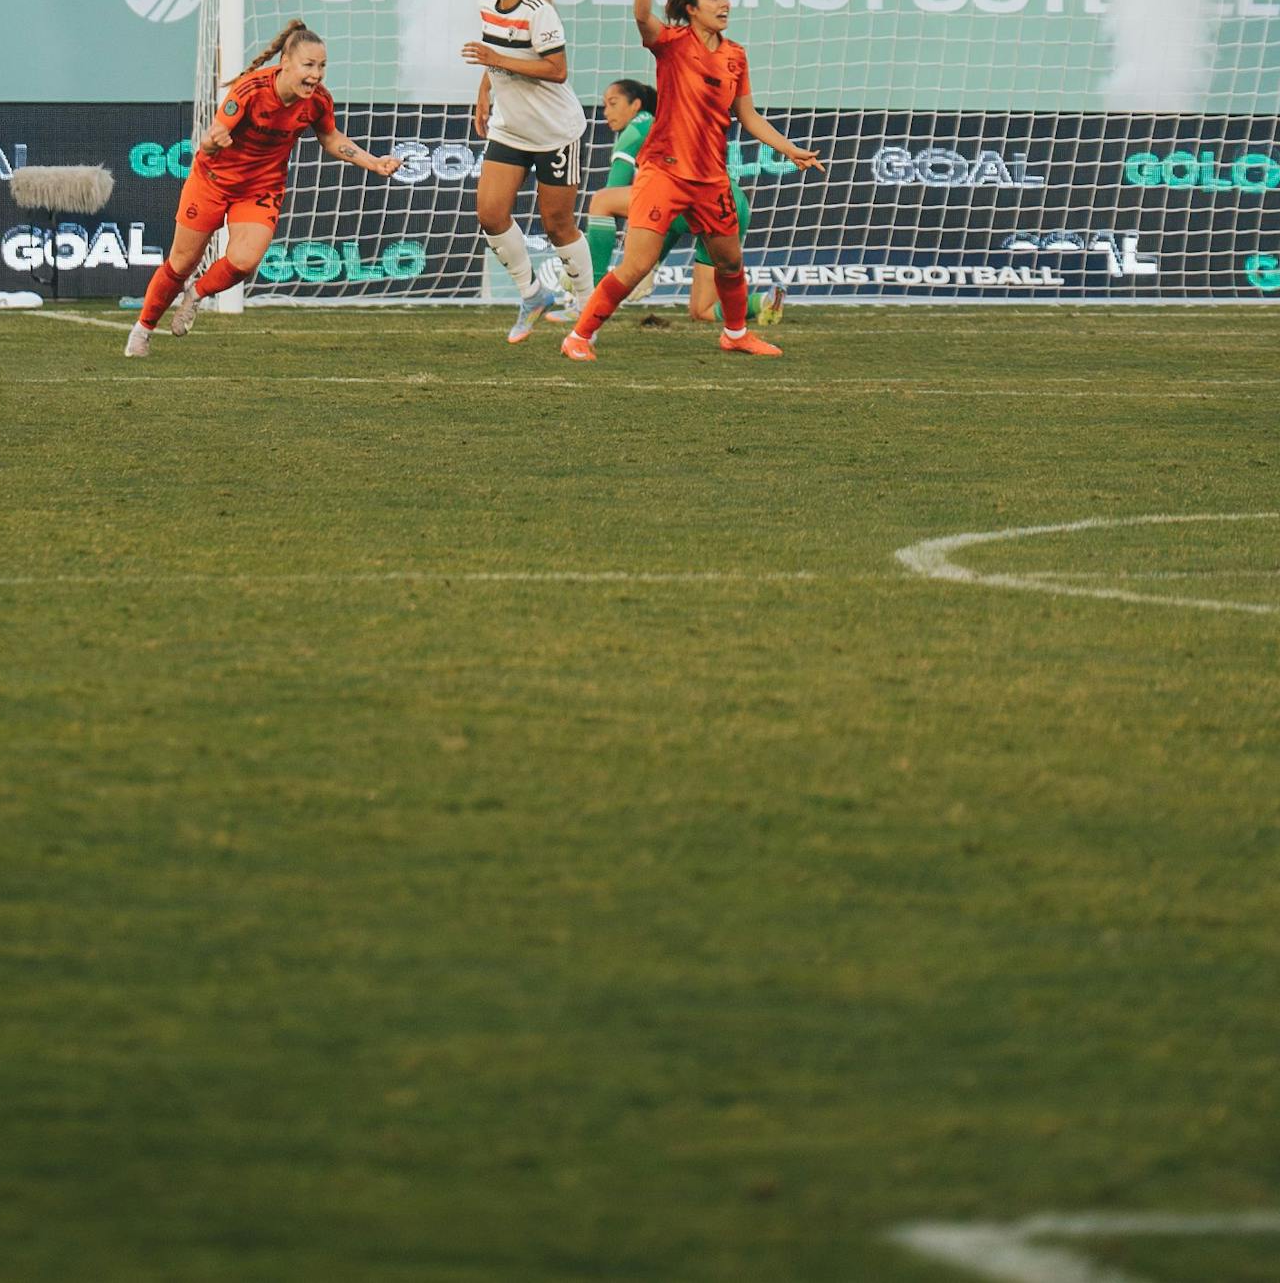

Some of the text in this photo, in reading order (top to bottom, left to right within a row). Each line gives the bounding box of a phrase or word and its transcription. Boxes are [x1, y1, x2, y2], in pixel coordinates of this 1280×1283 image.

[551, 146, 567, 169] 3
[871, 146, 1045, 189] GOAL
[1, 222, 164, 271] GOAL
[745, 265, 1065, 286] SEVENS FOOTBALL
